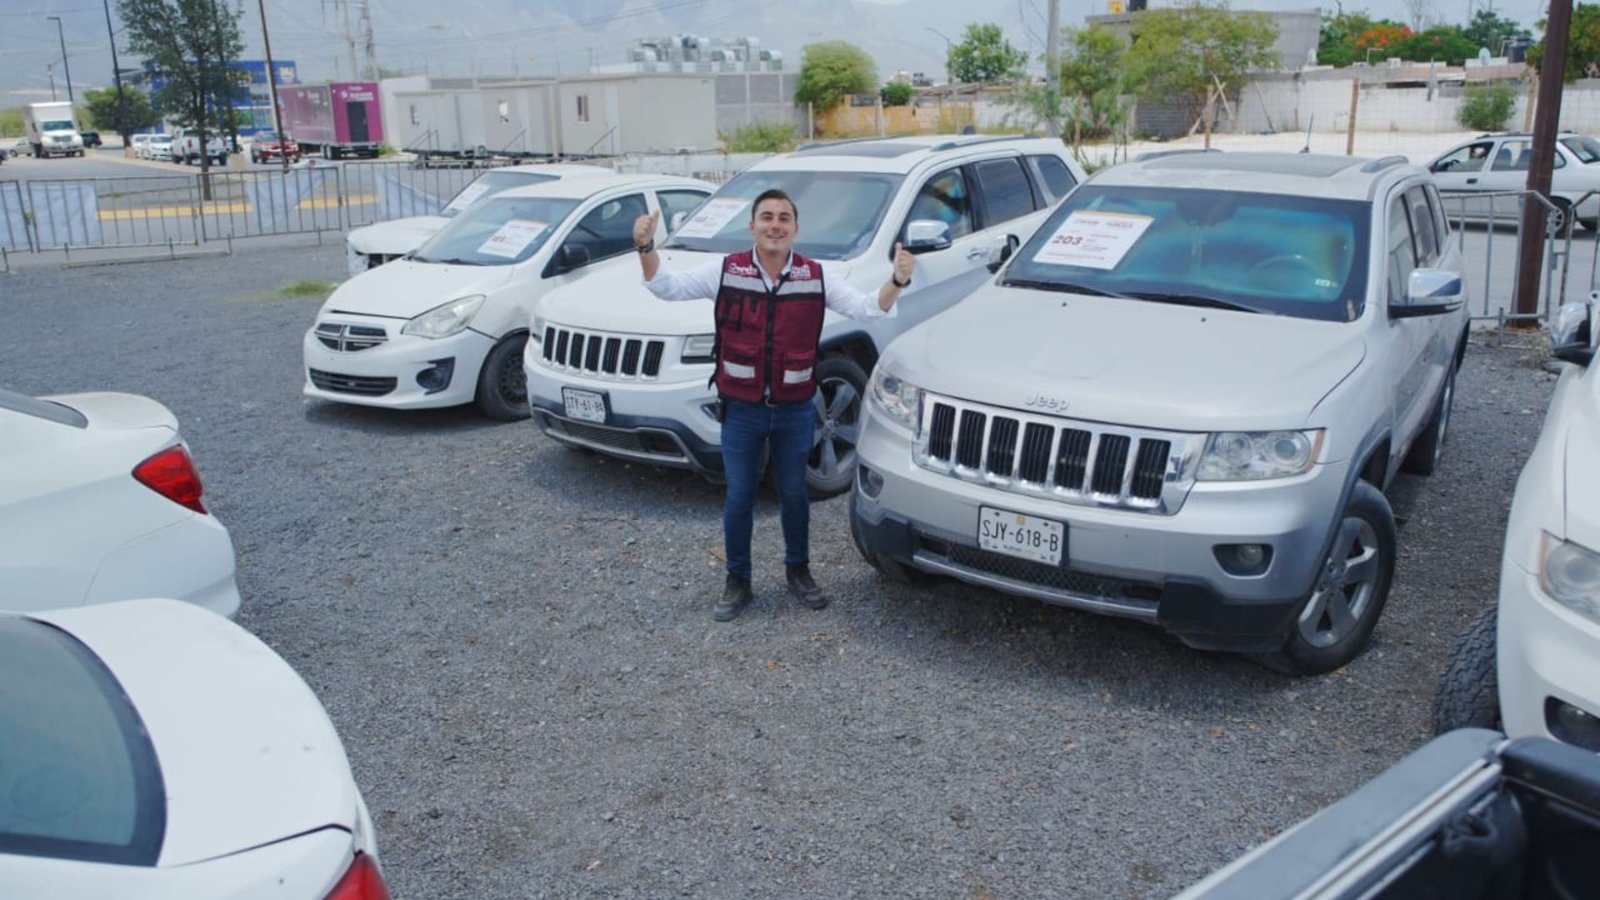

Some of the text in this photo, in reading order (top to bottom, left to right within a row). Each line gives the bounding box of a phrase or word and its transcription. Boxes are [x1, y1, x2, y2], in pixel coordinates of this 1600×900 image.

[1052, 234, 1083, 246] 203
[1025, 389, 1070, 412] Jeep
[982, 520, 1059, 552] SJY-618-B
